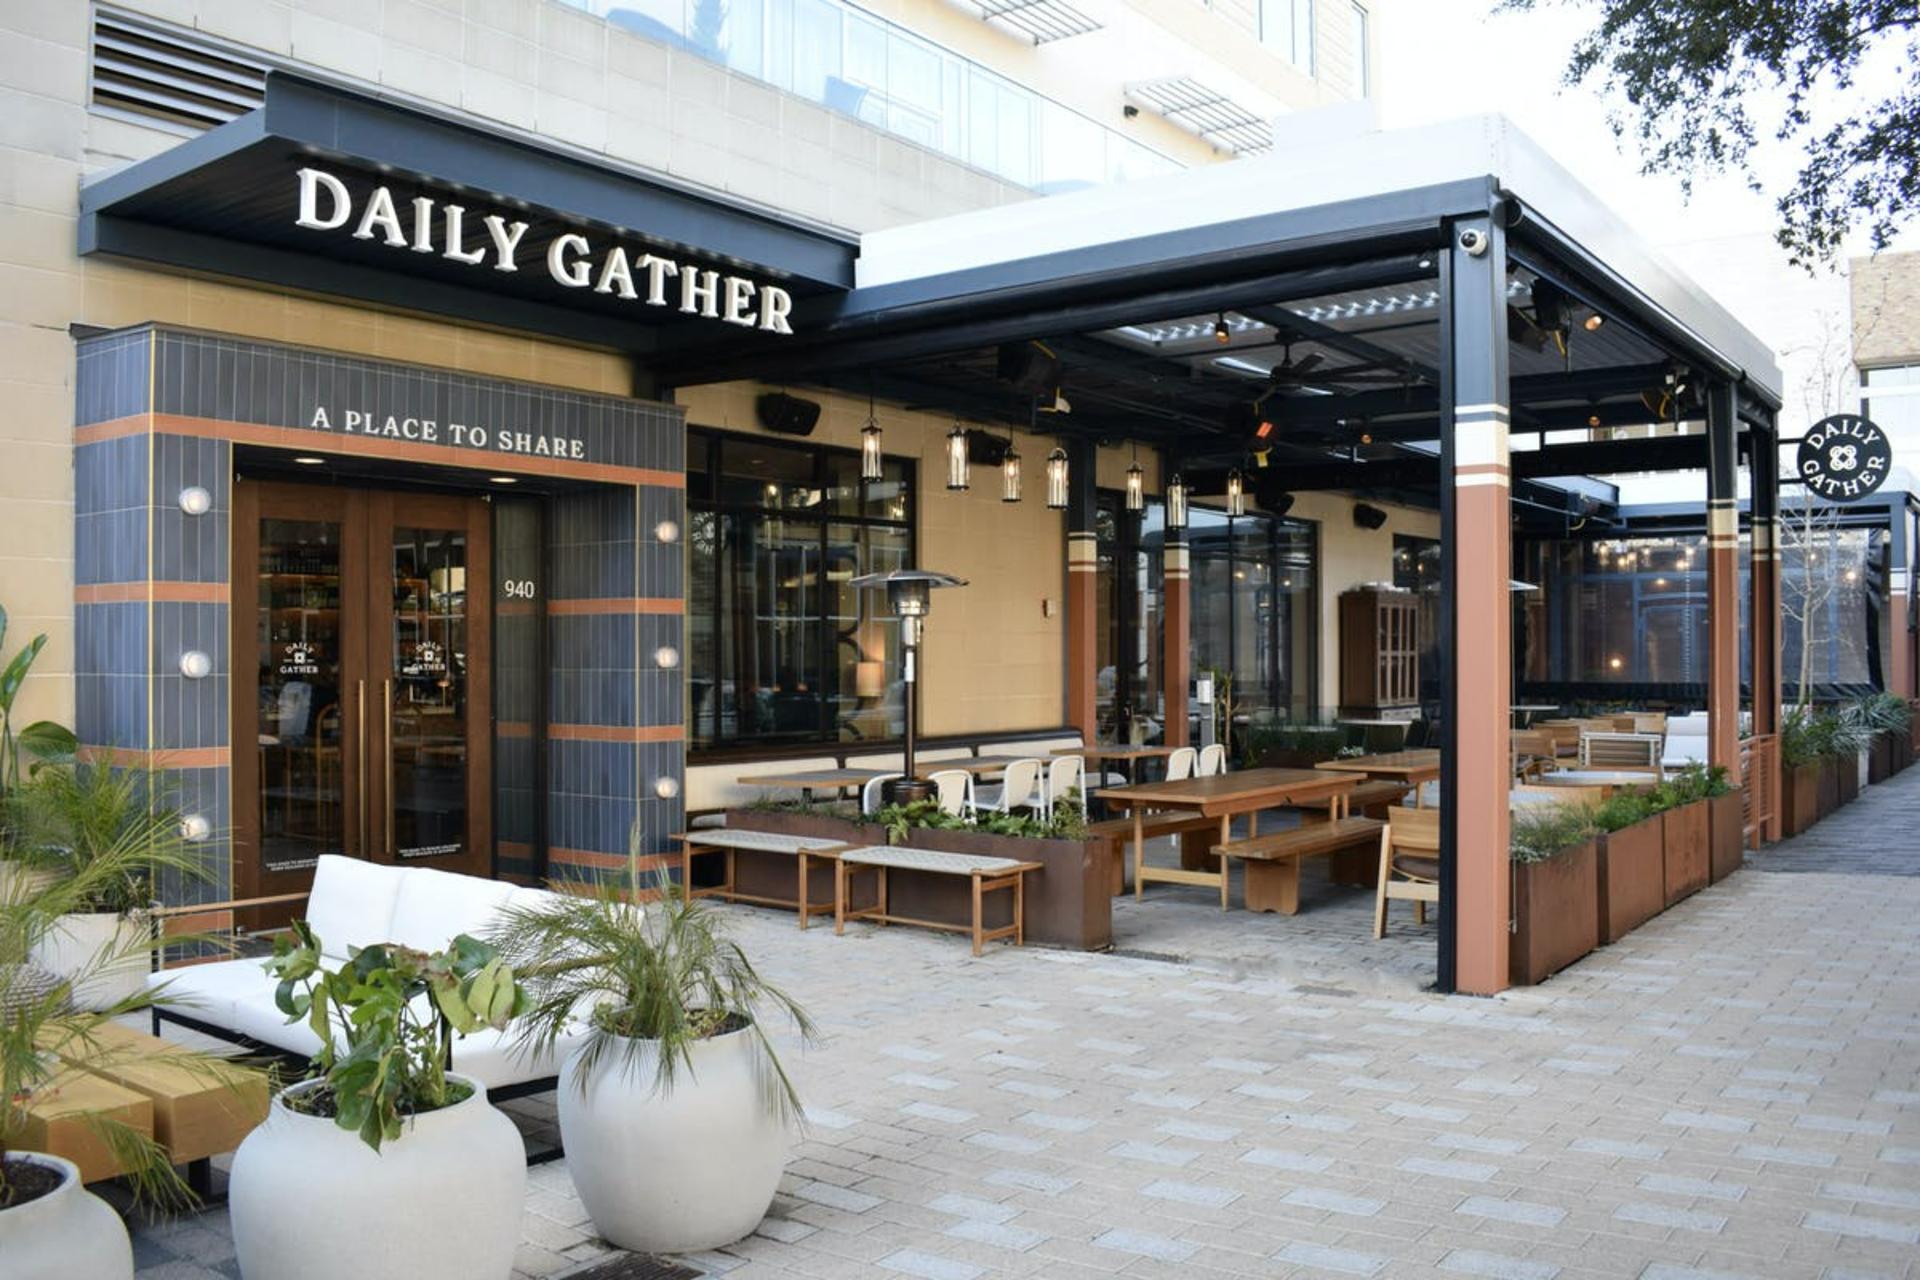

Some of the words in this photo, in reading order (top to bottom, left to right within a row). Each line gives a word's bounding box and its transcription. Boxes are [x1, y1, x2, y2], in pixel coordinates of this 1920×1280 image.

[295, 167, 529, 272] DAILY
[546, 232, 795, 335] GATHER
[311, 407, 331, 429] A
[345, 410, 438, 441] PLACE
[449, 424, 487, 447] TO
[498, 431, 585, 459] SHARE
[1806, 419, 1880, 450] DAILY
[1803, 456, 1885, 496] GATHER
[504, 580, 535, 599] 940
[285, 642, 314, 654] DAILY
[280, 665, 319, 674] GATHER
